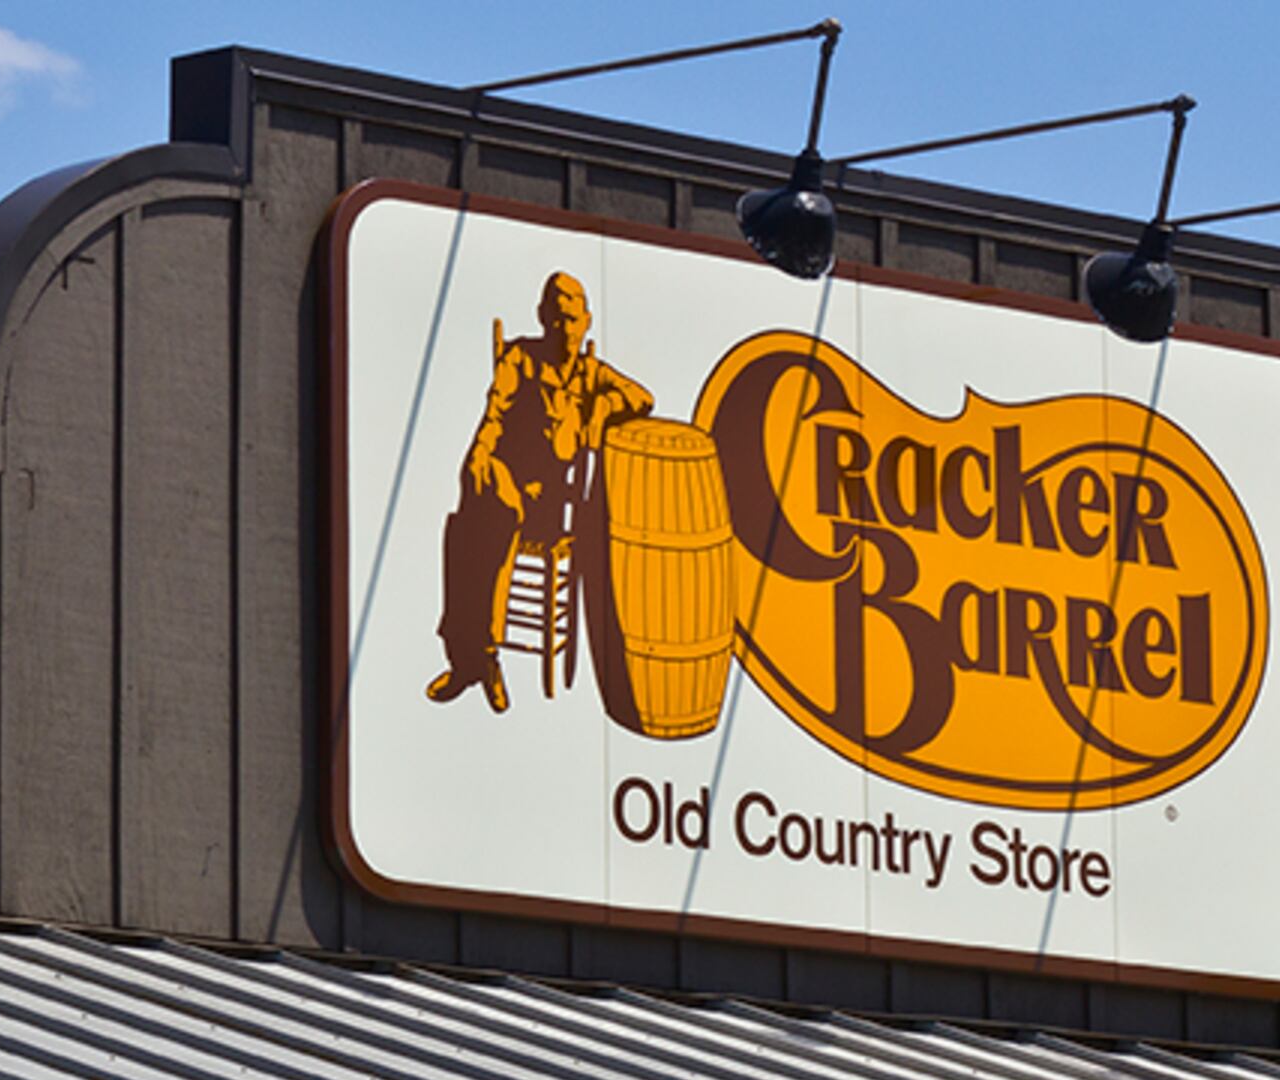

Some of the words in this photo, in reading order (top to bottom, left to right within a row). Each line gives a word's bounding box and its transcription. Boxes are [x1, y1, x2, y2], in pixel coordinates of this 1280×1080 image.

[710, 350, 1179, 582] Cracker
[830, 520, 1216, 757] Barrel
[613, 777, 711, 849] Old
[734, 791, 952, 888] Country
[969, 821, 1111, 897] Store
